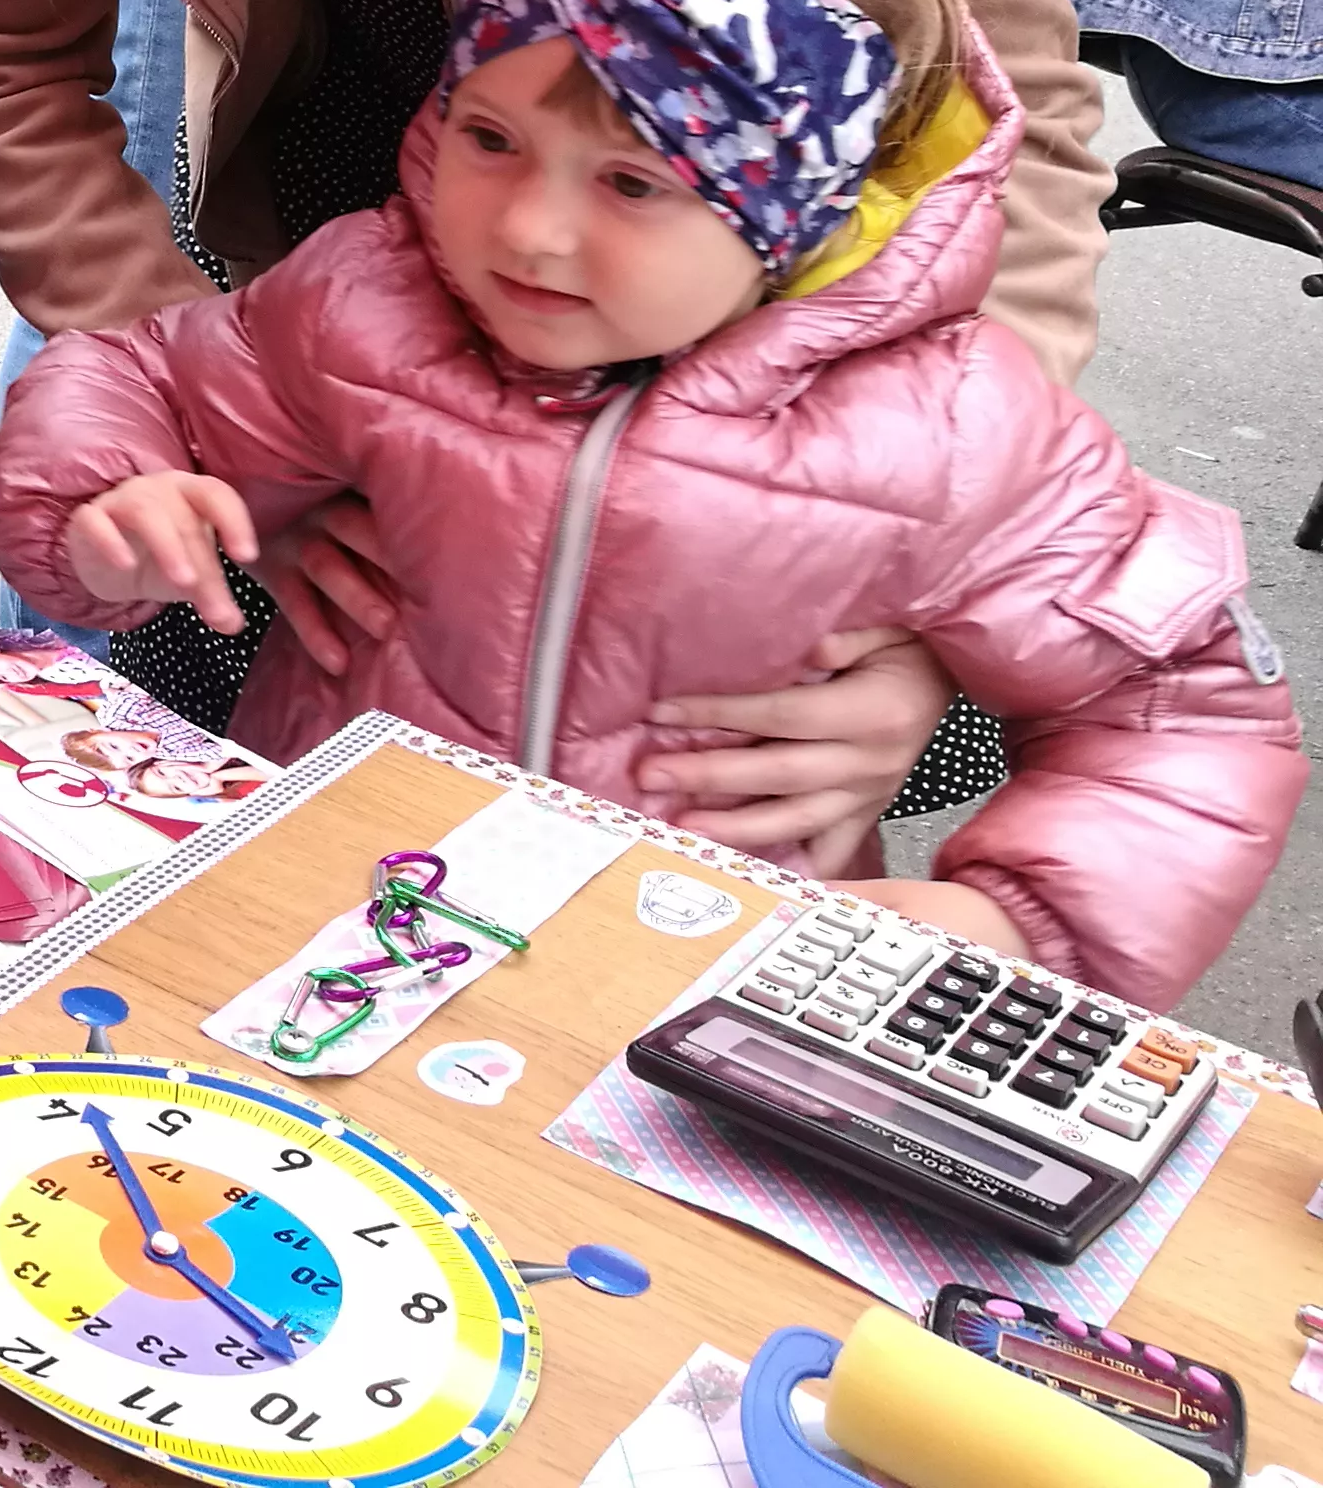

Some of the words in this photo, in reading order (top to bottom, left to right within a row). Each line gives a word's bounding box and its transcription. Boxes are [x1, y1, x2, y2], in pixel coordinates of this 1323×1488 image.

[924, 996, 945, 1010] 6
[1006, 1002, 1028, 1015] 2
[1089, 1009, 1110, 1023] 0
[906, 1015, 928, 1031] 9
[884, 1032, 911, 1049] MR
[970, 1040, 991, 1056] 8
[1155, 1032, 1189, 1056] ON/C
[171, 1059, 187, 1069] 25
[946, 1059, 975, 1075] MC
[1136, 1053, 1168, 1071] CE
[36, 1097, 81, 1122] 4
[1098, 1096, 1134, 1114] OFF
[145, 1109, 193, 1139] 5
[851, 1116, 953, 1165] CALCULATOR
[147, 1161, 188, 1186] 17
[270, 1147, 314, 1175] 6
[891, 1142, 999, 1197] KK-800A
[29, 1177, 69, 1203] 15
[222, 1185, 262, 1212] 18
[956, 1161, 1058, 1212] ELECTRONIC
[4, 1211, 43, 1240] 14
[353, 1221, 402, 1250] 7
[271, 1227, 314, 1253] 19
[13, 1259, 54, 1290] 13
[289, 1265, 342, 1298] 20
[63, 1304, 114, 1338] 24
[399, 1291, 450, 1326] 8
[134, 1333, 190, 1368] 23
[213, 1334, 267, 1370] 22
[117, 1384, 185, 1428] 11
[364, 1377, 412, 1409] 9
[248, 1391, 324, 1443] 10
